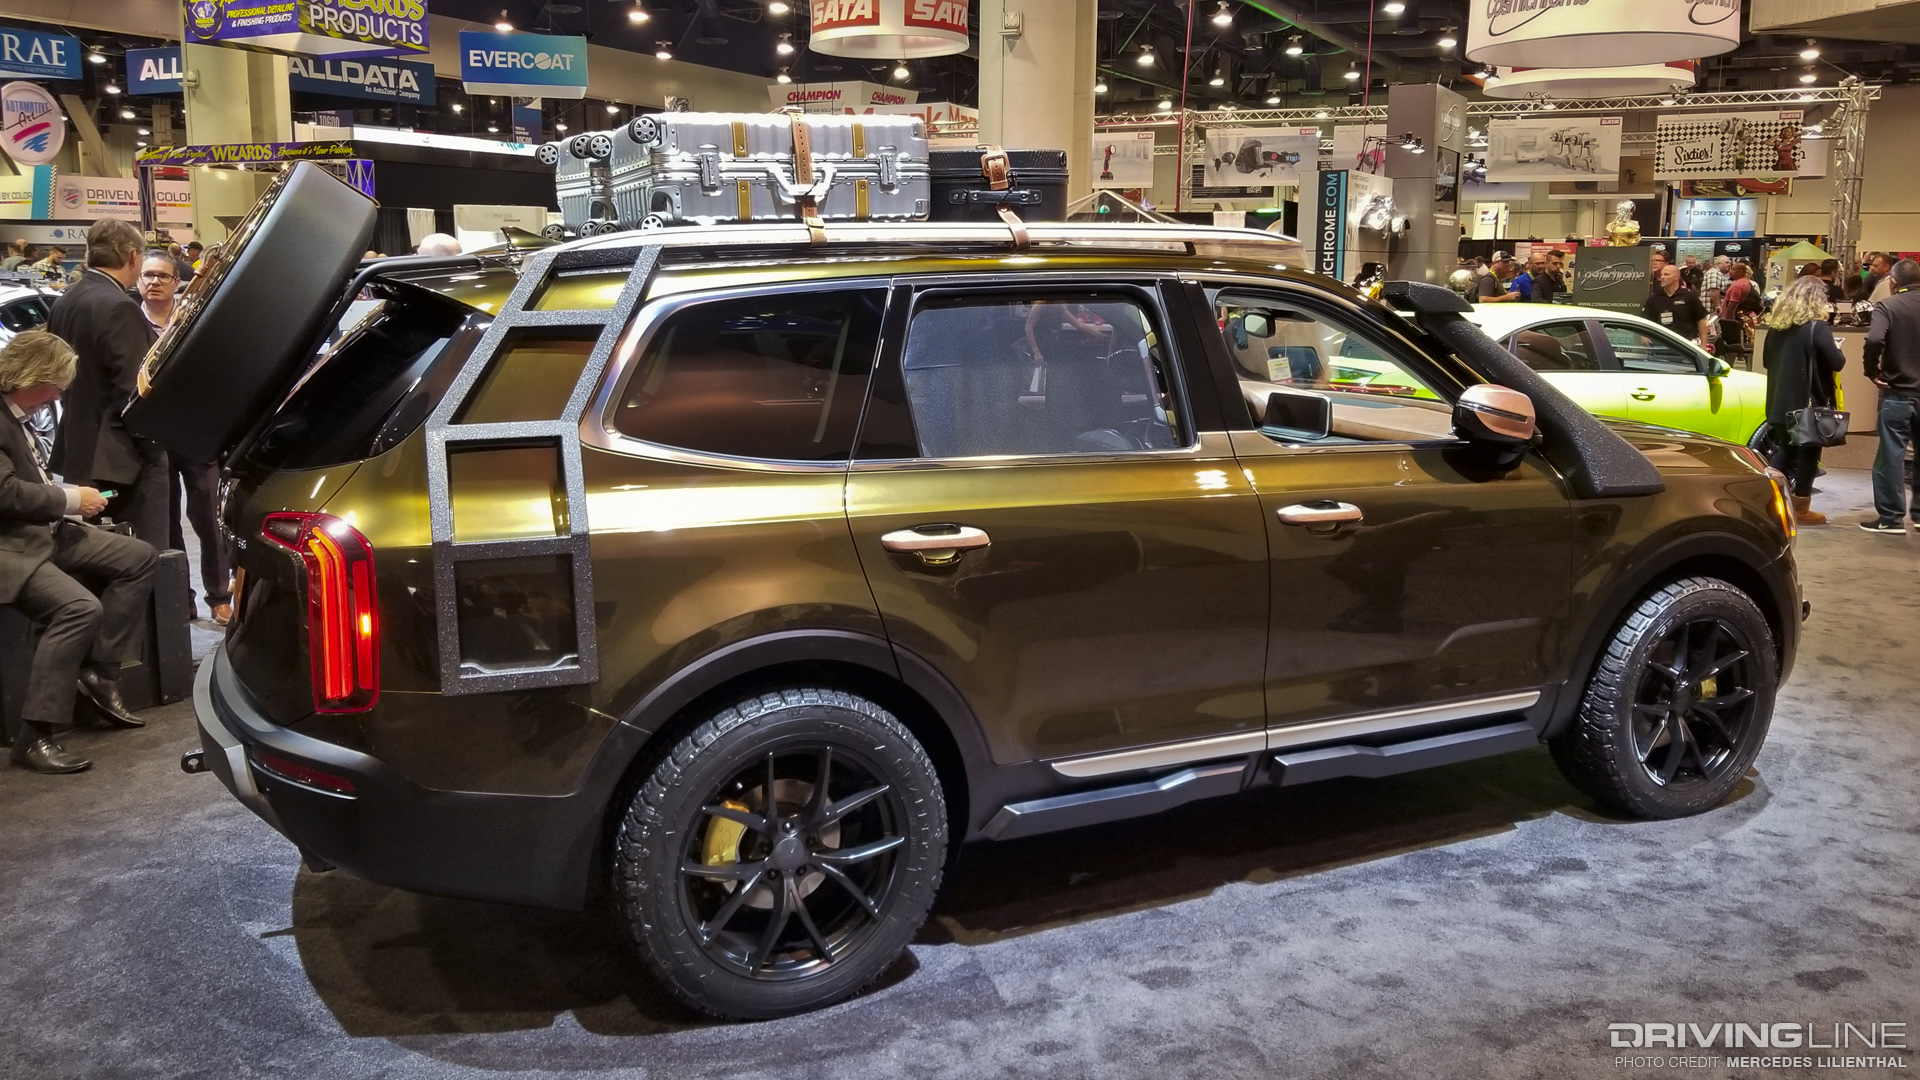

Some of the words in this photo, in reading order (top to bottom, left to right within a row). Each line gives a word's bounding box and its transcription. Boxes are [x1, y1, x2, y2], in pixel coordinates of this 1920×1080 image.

[227, 7, 266, 18] PROFESSIONAL
[267, 3, 295, 14] DETAILING
[813, 0, 873, 27] SATA
[231, 20, 237, 28] &
[237, 17, 264, 27] FINISHING
[264, 13, 292, 24] PRODUCTS
[310, 4, 423, 45] PRODUCTS
[1, 33, 67, 67] RAE
[469, 50, 574, 70] EVERCOAT
[288, 56, 420, 92] ALLDATA
[787, 90, 841, 101] CHAMPION
[871, 91, 907, 105] CHAMPION
[6, 101, 48, 113] AUTOMOTIVE
[211, 144, 272, 161] WIZARDS
[277, 146, 302, 156] Because
[313, 145, 328, 155] Your
[329, 144, 353, 154] Passion
[1674, 142, 1713, 166] Sixties!
[87, 189, 133, 200] DRIVEN
[1578, 268, 1645, 281] Cosmichrome
